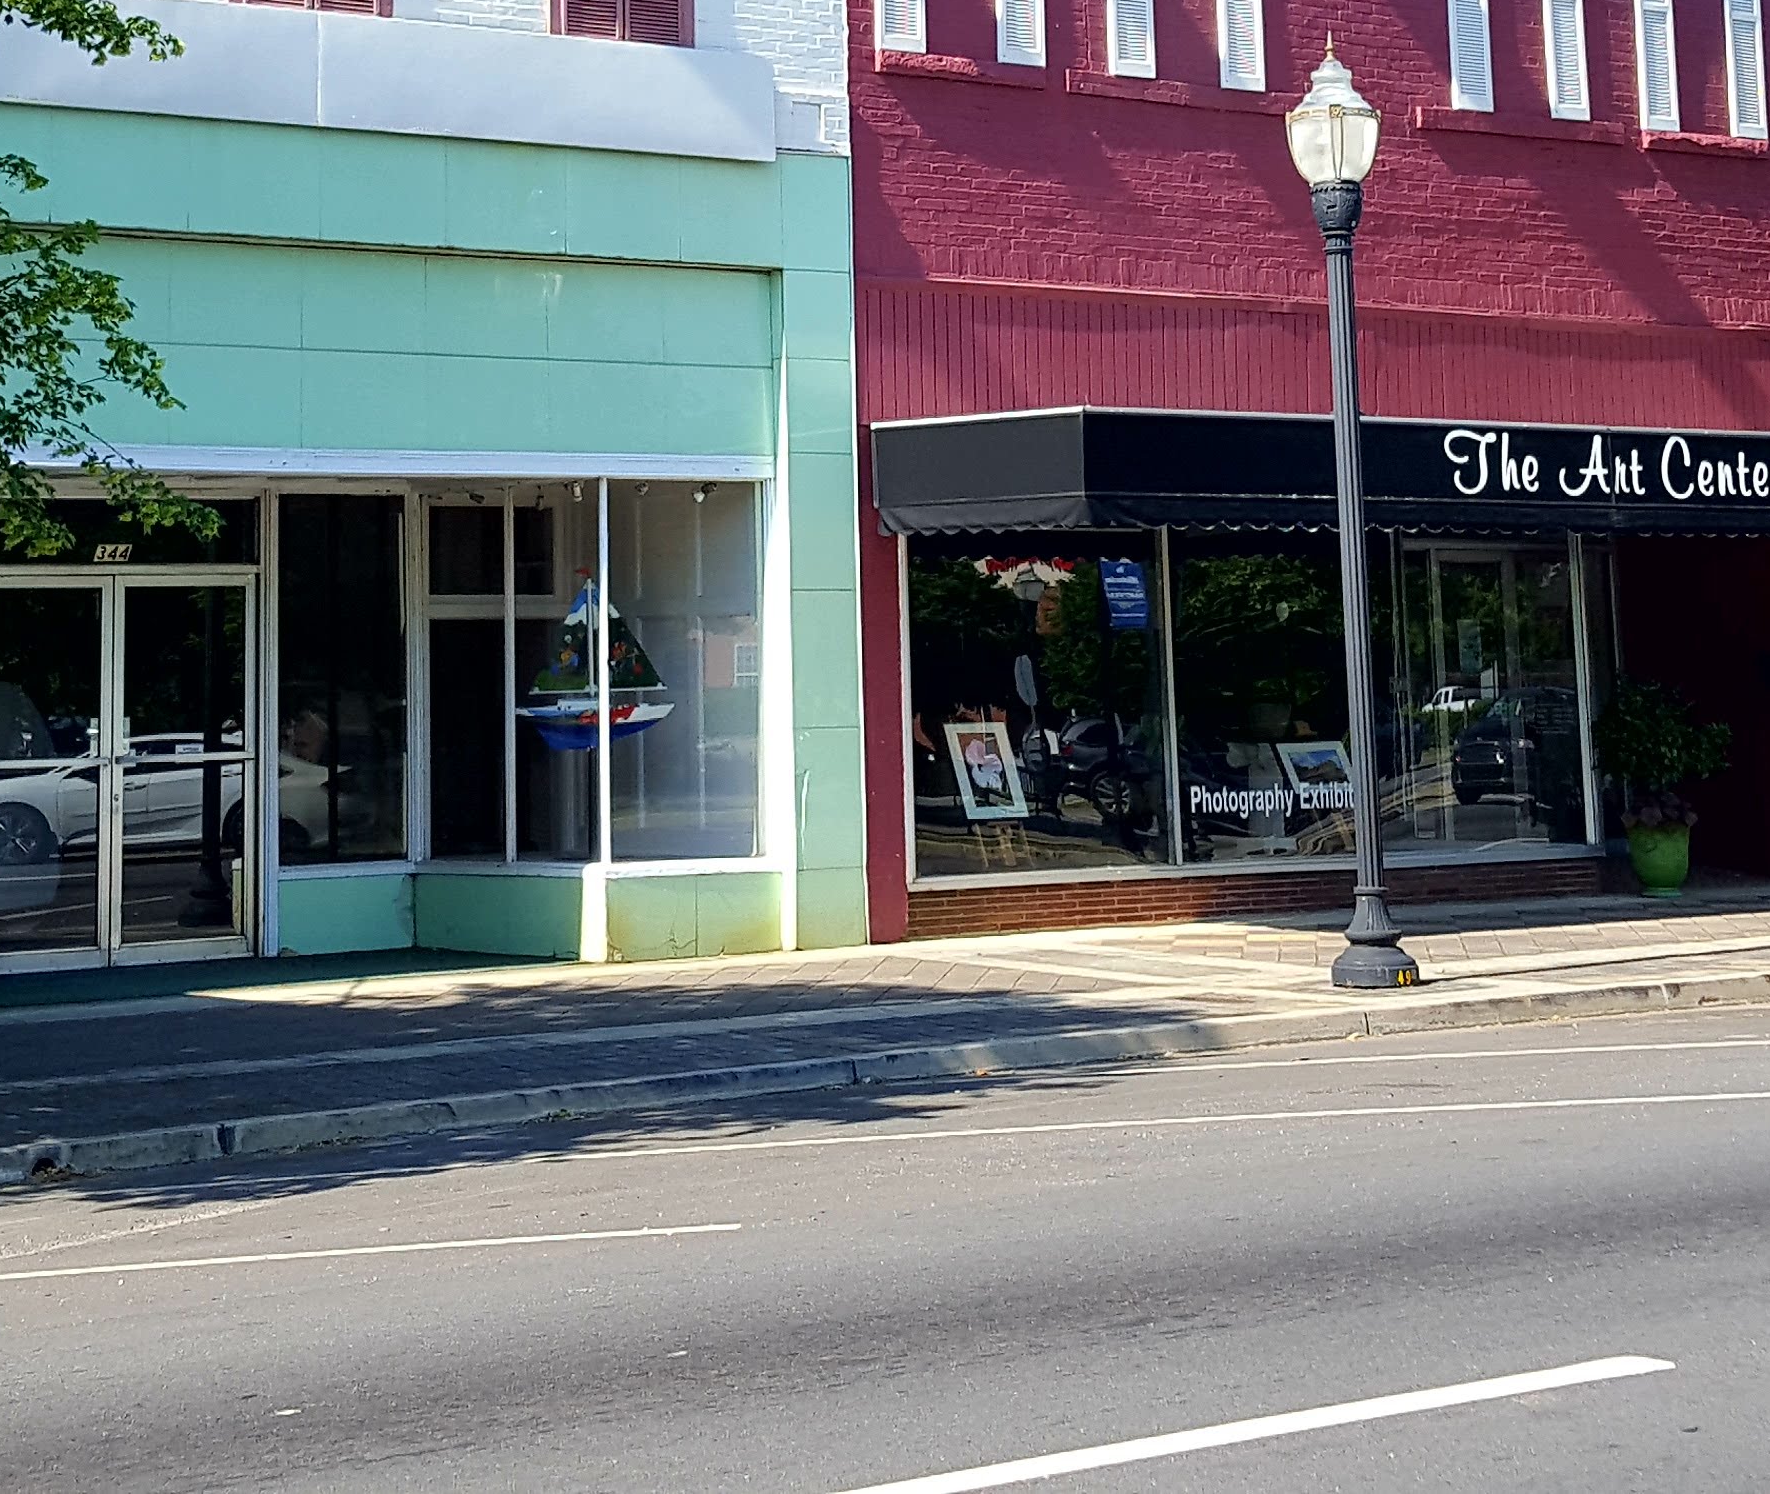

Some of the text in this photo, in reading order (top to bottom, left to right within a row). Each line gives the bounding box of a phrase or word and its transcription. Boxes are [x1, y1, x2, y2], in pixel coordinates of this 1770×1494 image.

[1443, 428, 1540, 495] The
[1558, 433, 1646, 497] Art
[96, 545, 130, 560] 344
[1190, 780, 1355, 820] Photography Exhibit
